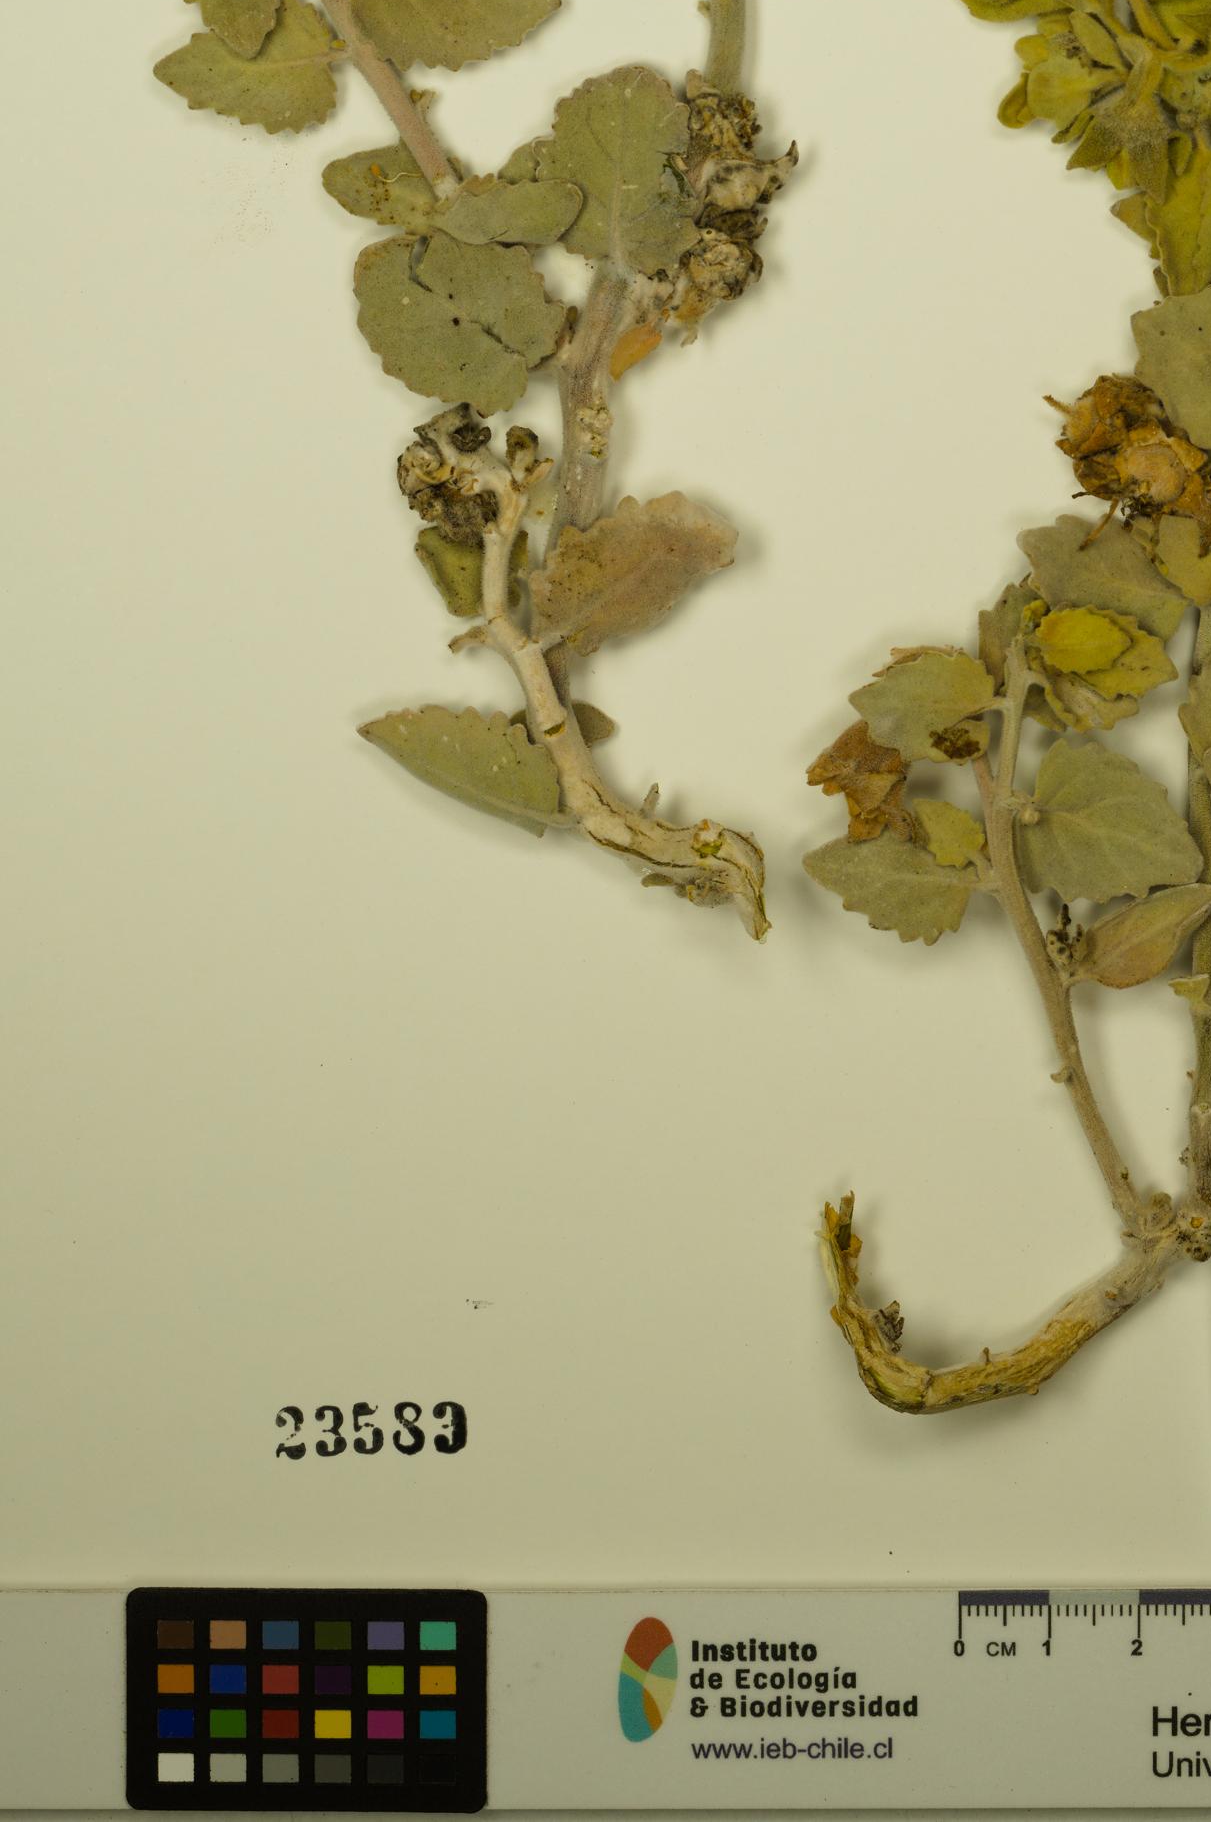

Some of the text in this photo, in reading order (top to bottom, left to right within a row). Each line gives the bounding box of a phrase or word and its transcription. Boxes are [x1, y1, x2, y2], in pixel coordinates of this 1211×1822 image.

[692, 1638, 818, 1662] Instituto
[953, 1640, 966, 1657] 0
[985, 1642, 1017, 1657] CM
[1041, 1639, 1051, 1656] 1
[1130, 1639, 1143, 1656] 2
[690, 1666, 857, 1693] de Ecología
[690, 1695, 918, 1718] & Biodiversidad
[691, 1737, 893, 1759] www.ieb-chile.cl
